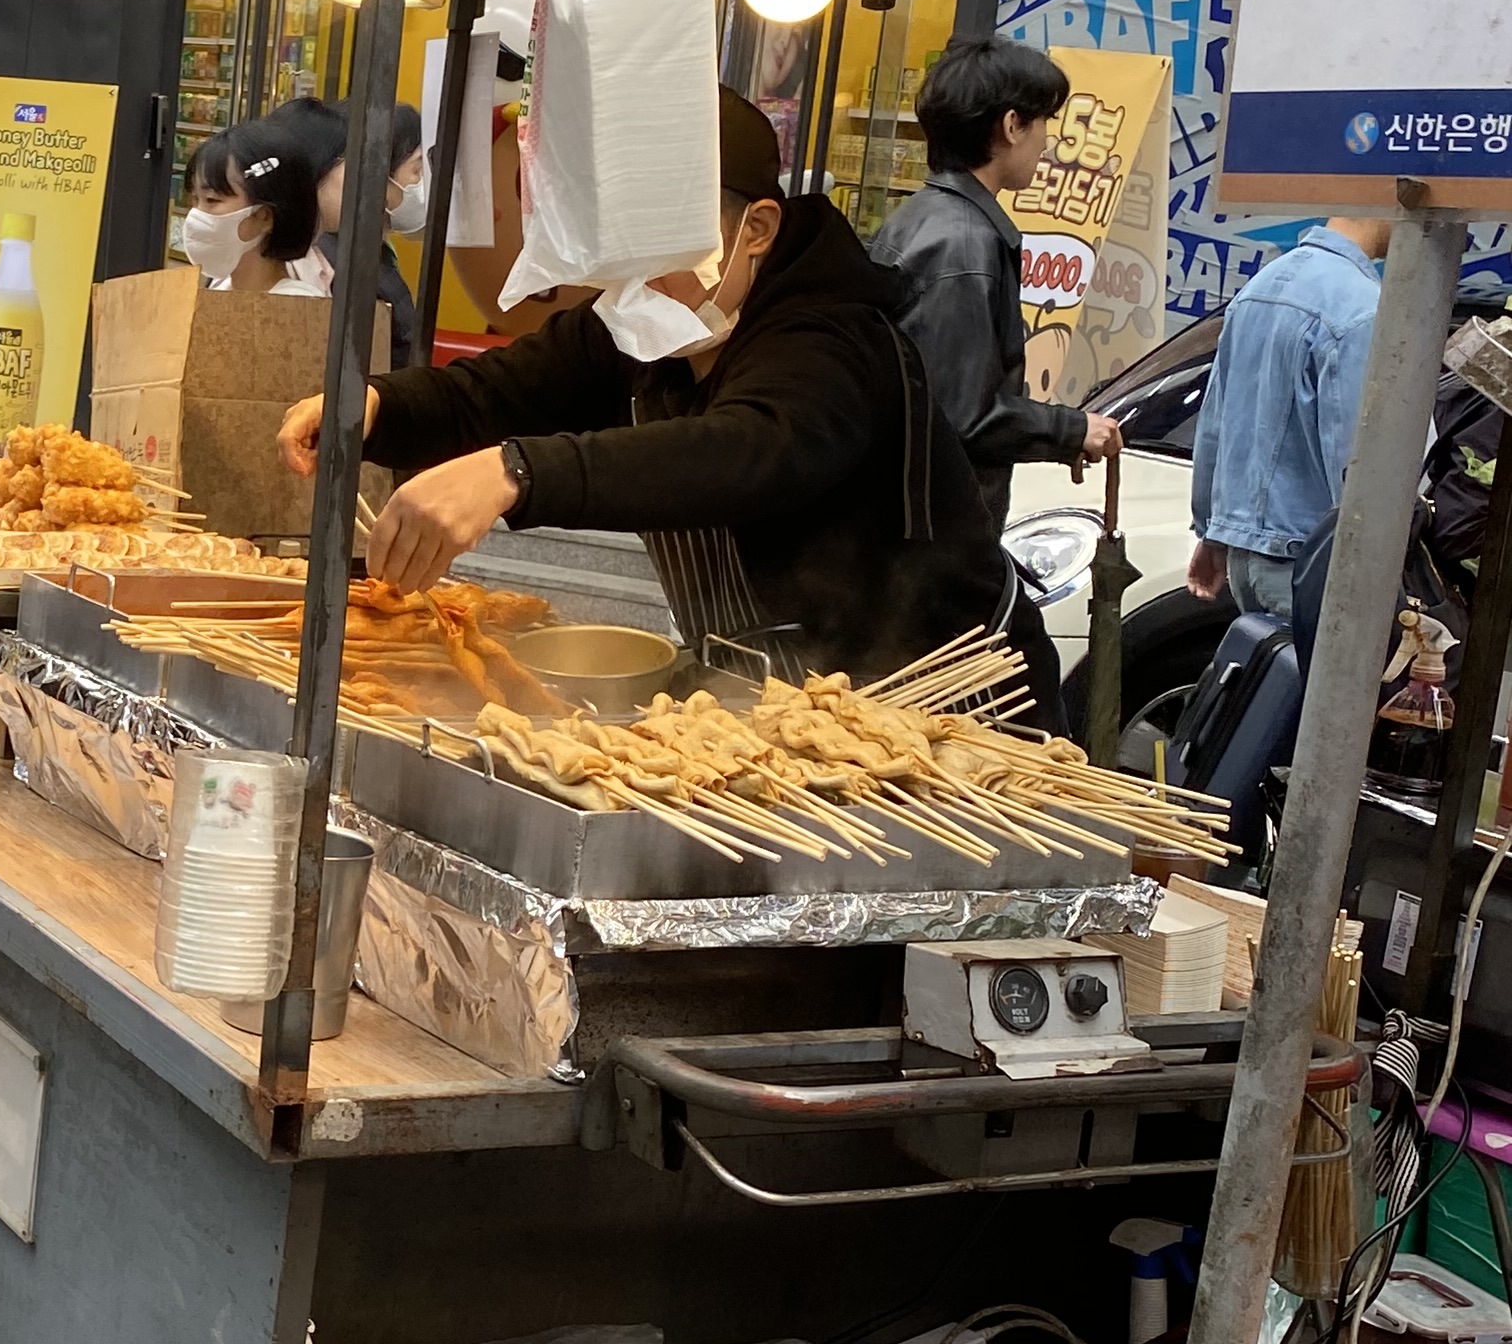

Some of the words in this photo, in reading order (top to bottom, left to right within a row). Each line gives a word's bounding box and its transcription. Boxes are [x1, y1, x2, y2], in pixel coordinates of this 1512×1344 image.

[33, 127, 87, 149] Butter
[1384, 112, 1512, 154] 신한은행
[22, 150, 97, 176] Makgeolli
[20, 175, 48, 191] with
[53, 177, 92, 195] HBAF
[1011, 1007, 1029, 1016] VOLT
